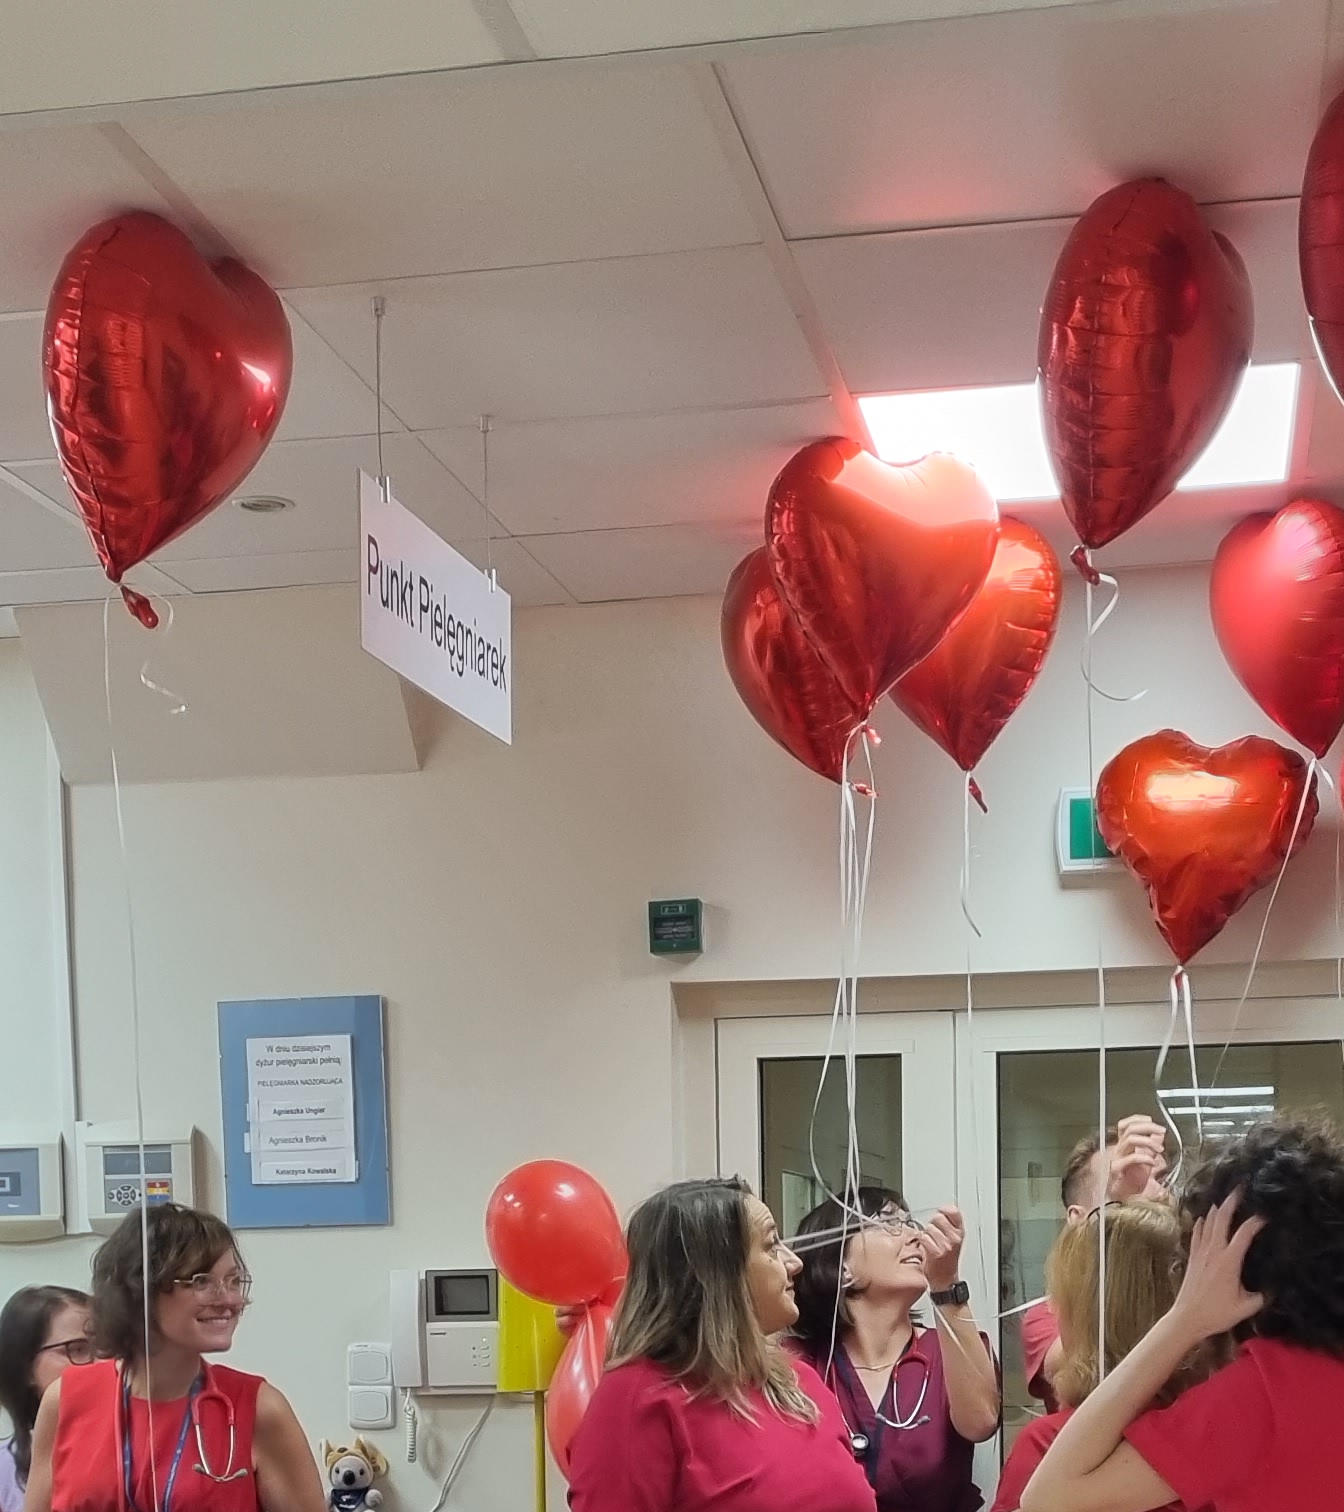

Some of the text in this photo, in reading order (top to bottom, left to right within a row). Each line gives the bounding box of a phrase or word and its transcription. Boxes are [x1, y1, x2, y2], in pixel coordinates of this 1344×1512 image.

[367, 533, 507, 693] Punkt Pielęgniarek
[273, 1108, 303, 1116] Agnieszka
[269, 1136, 303, 1146] Agnieszka
[276, 1168, 306, 1176] Katarzyna
